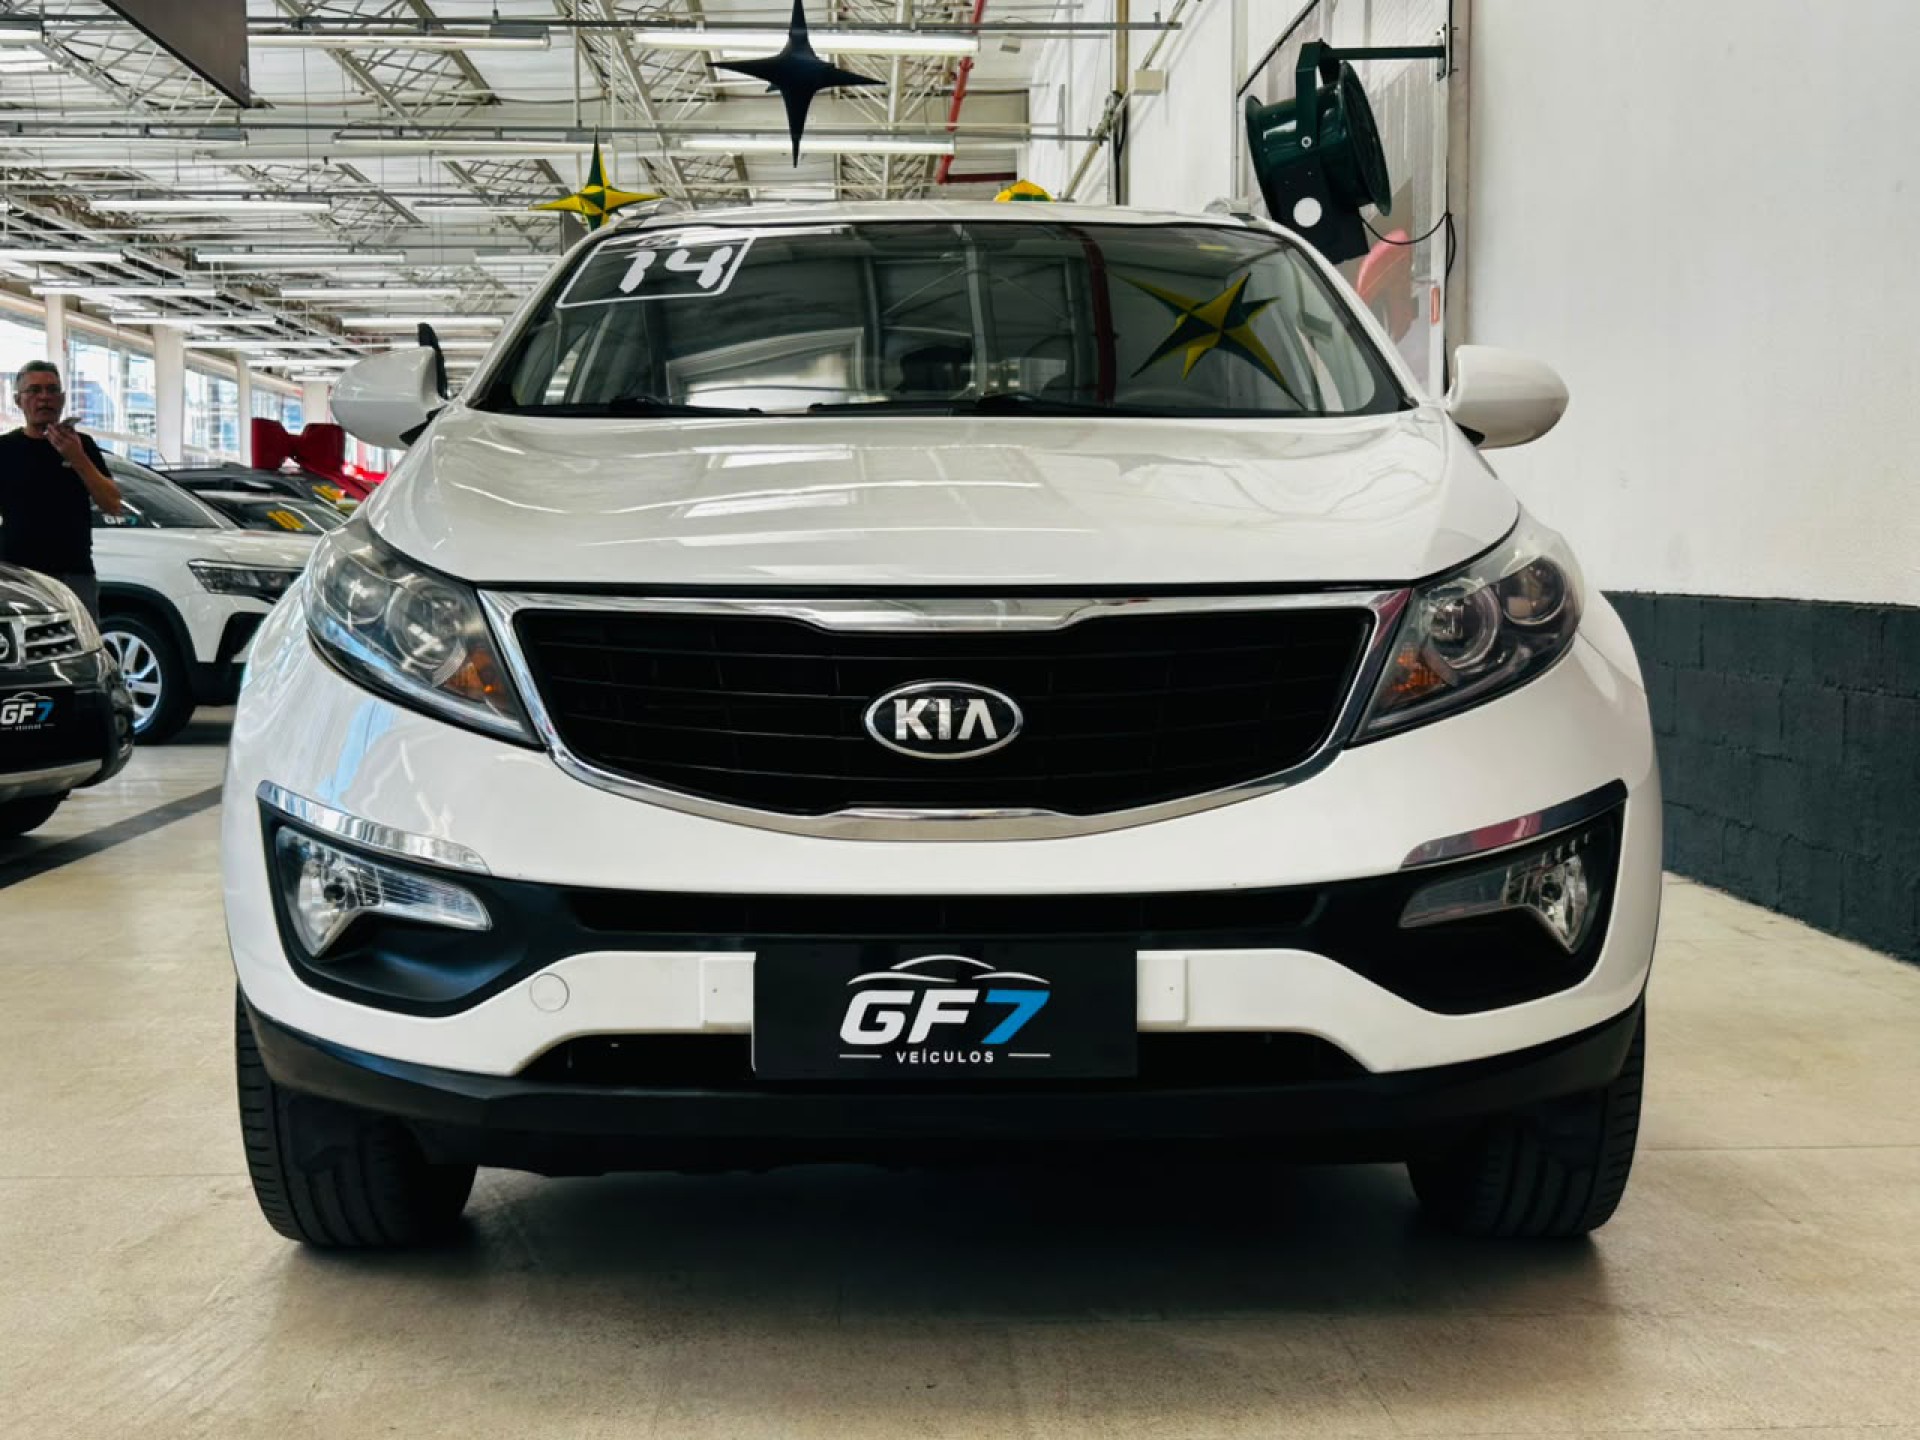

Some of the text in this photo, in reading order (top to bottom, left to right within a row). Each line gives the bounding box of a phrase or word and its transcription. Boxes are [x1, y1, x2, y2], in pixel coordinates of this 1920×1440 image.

[619, 246, 733, 293] 14
[0, 702, 54, 724] GF7
[894, 698, 999, 741] KIA
[839, 989, 1051, 1045] GF7
[896, 1048, 995, 1064] VEÍCULOS
